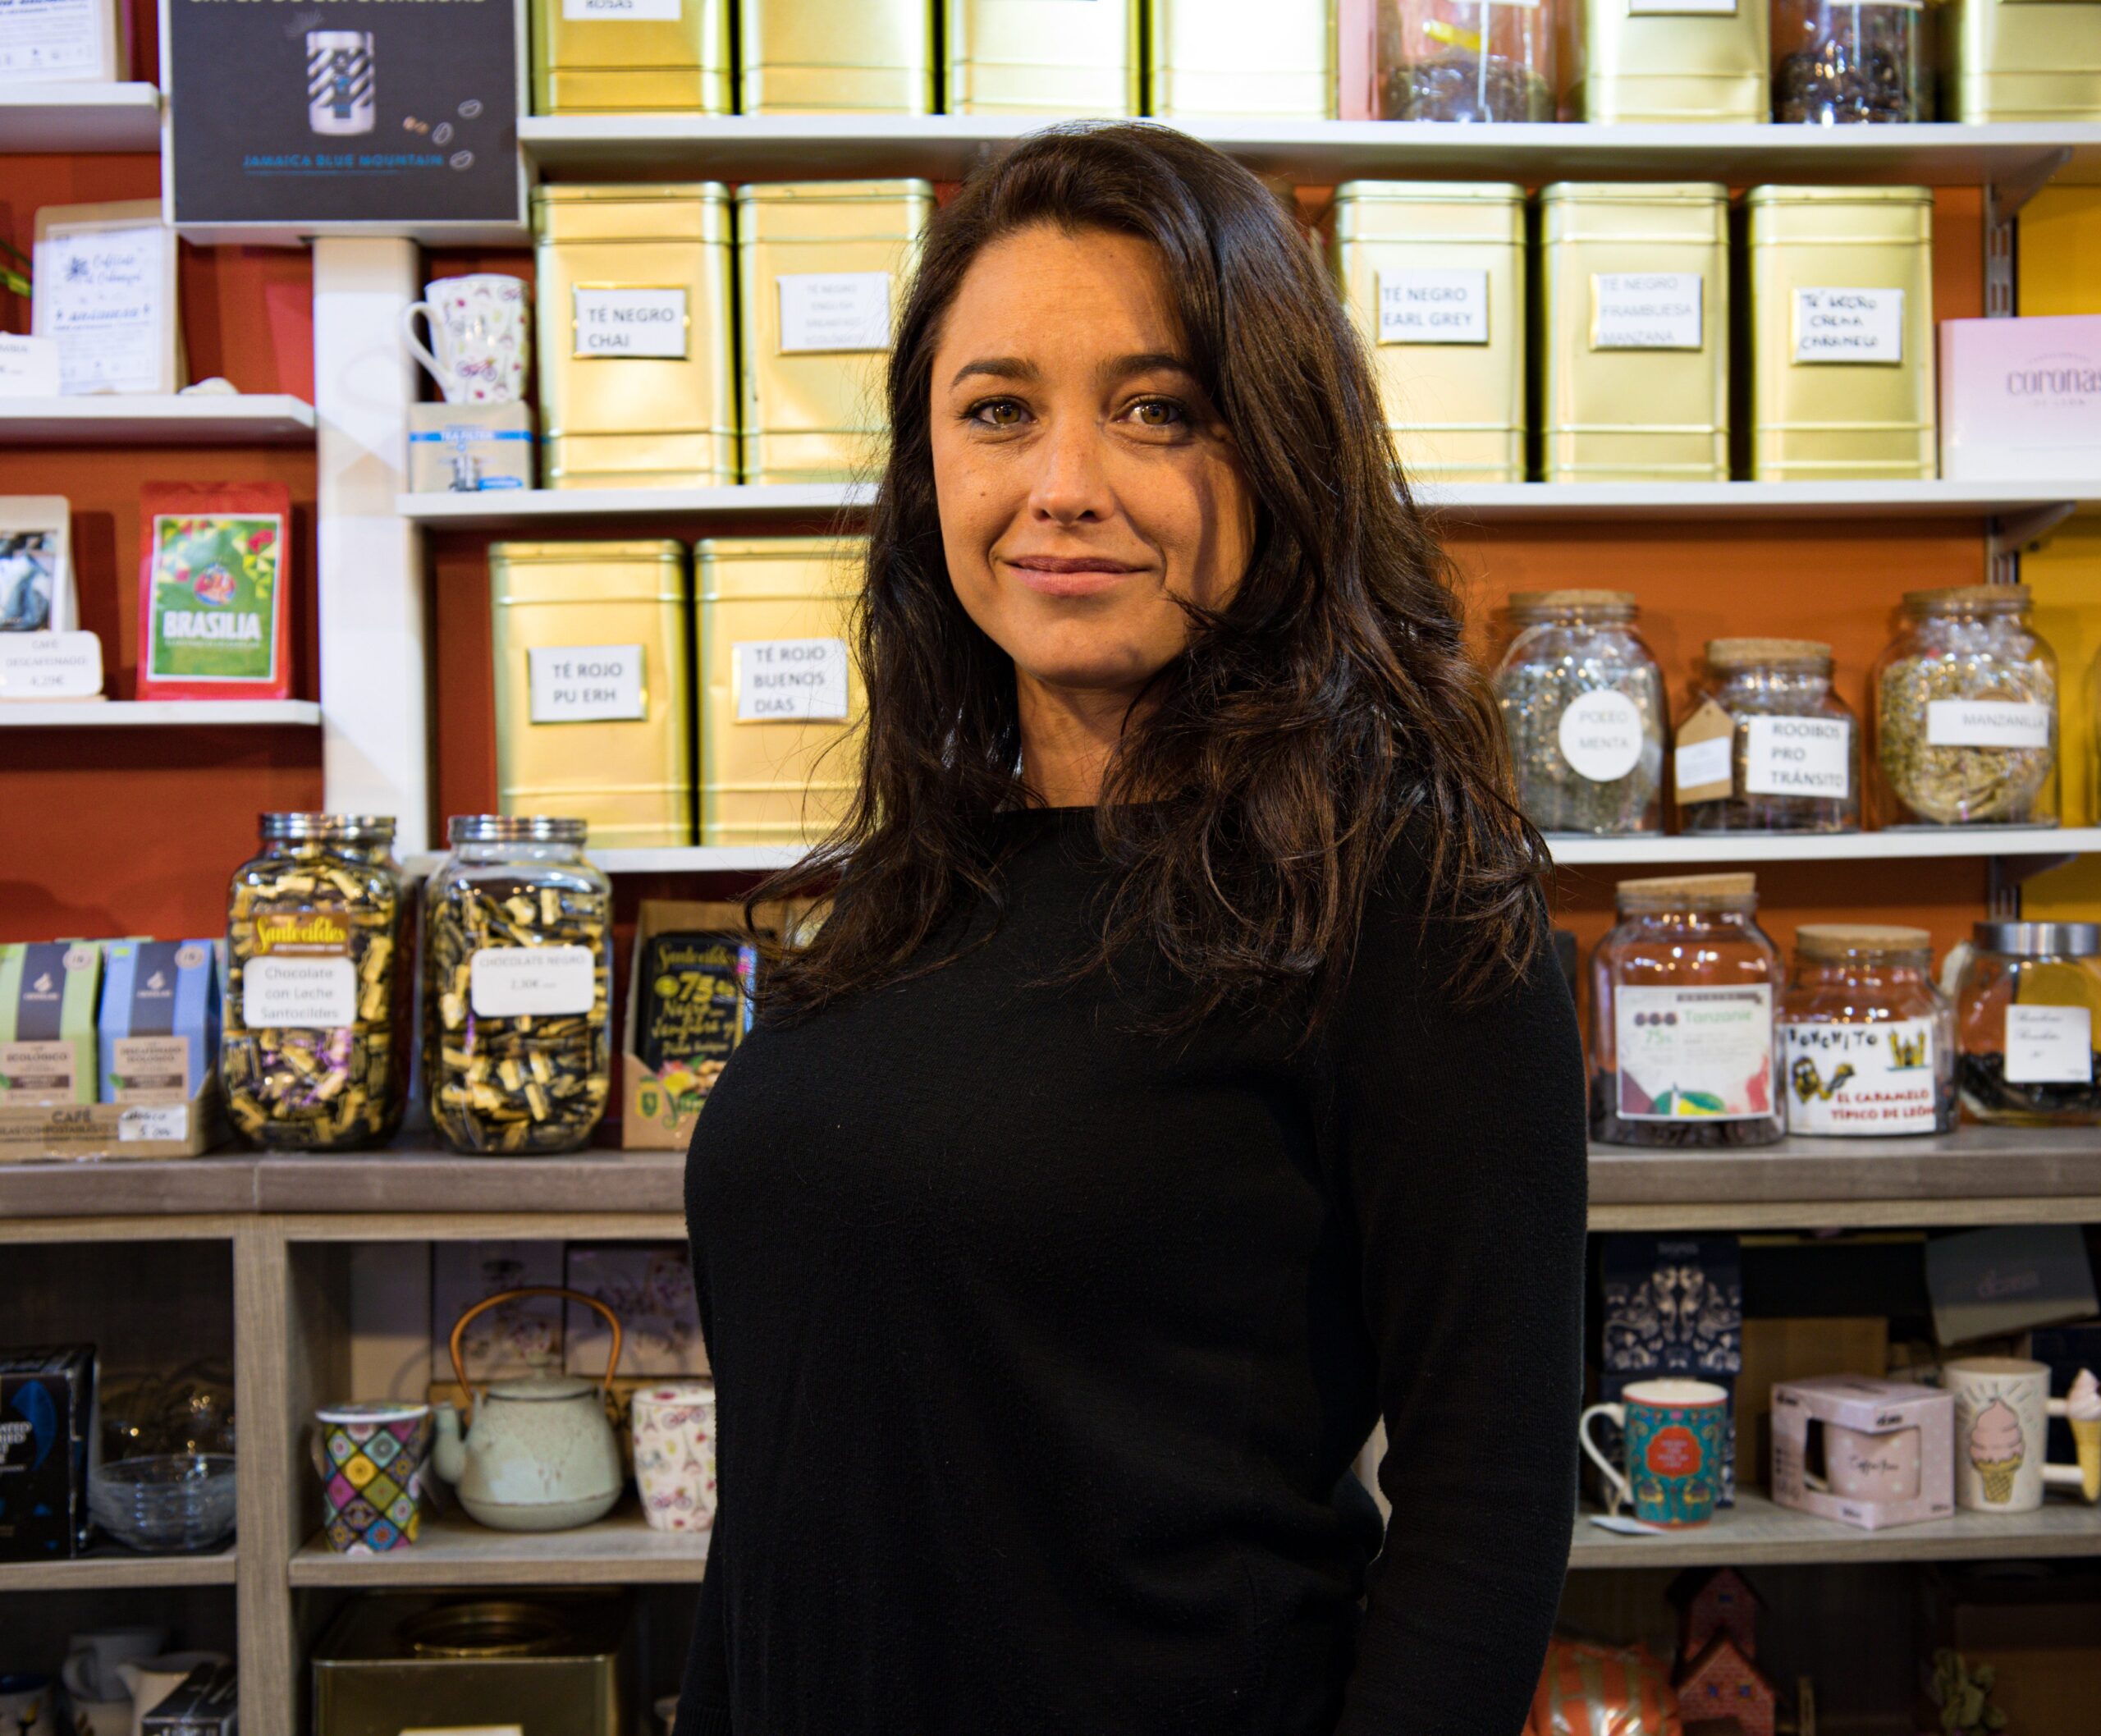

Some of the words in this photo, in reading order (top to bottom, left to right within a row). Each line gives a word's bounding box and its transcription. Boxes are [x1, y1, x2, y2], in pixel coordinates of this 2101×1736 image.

[244, 153, 310, 167] JAMAICA
[315, 153, 354, 167] BLUE
[359, 153, 444, 166] MOUNTAIN
[1623, 277, 1678, 291] NEGRO
[1384, 284, 1401, 301] TÉ
[1408, 287, 1467, 301] NEGRO
[587, 304, 607, 323] TÉ
[613, 307, 675, 323] NEGRO
[1601, 302, 1693, 318] FRAMBUESA
[1384, 313, 1423, 326] EARL
[1429, 312, 1473, 326] GREY
[588, 332, 629, 348] CHAI
[162, 610, 263, 640] BRASILIA
[32, 639, 58, 649] CAFÉ
[754, 645, 773, 662] TÉ
[780, 646, 826, 662] ROJO
[553, 660, 571, 679] TÉ
[577, 662, 623, 678] ROJO
[753, 671, 826, 689] BUENOS
[553, 689, 576, 703] PU
[583, 688, 616, 703] ERH
[1962, 712, 2046, 729] MANZANILLA
[1771, 722, 1842, 740] ROOIBOS
[1579, 737, 1630, 750] MENTA
[1770, 746, 1806, 762] PRO
[1769, 767, 1844, 789] TRÁNSITO
[254, 915, 348, 955] Santocildes
[478, 955, 544, 968] CHOCOLATE
[547, 954, 585, 966] NEGRO
[264, 965, 334, 981] Chocolate
[265, 989, 289, 1000] con
[294, 987, 334, 1001] Leche
[260, 1006, 340, 1020] Santocildes
[1683, 1010, 1753, 1024] Tanzanie
[1836, 1092, 1850, 1104] EL
[1855, 1089, 1929, 1104] CARAMELO
[52, 1108, 93, 1124] CAFÉ
[1882, 1107, 1899, 1120] DE
